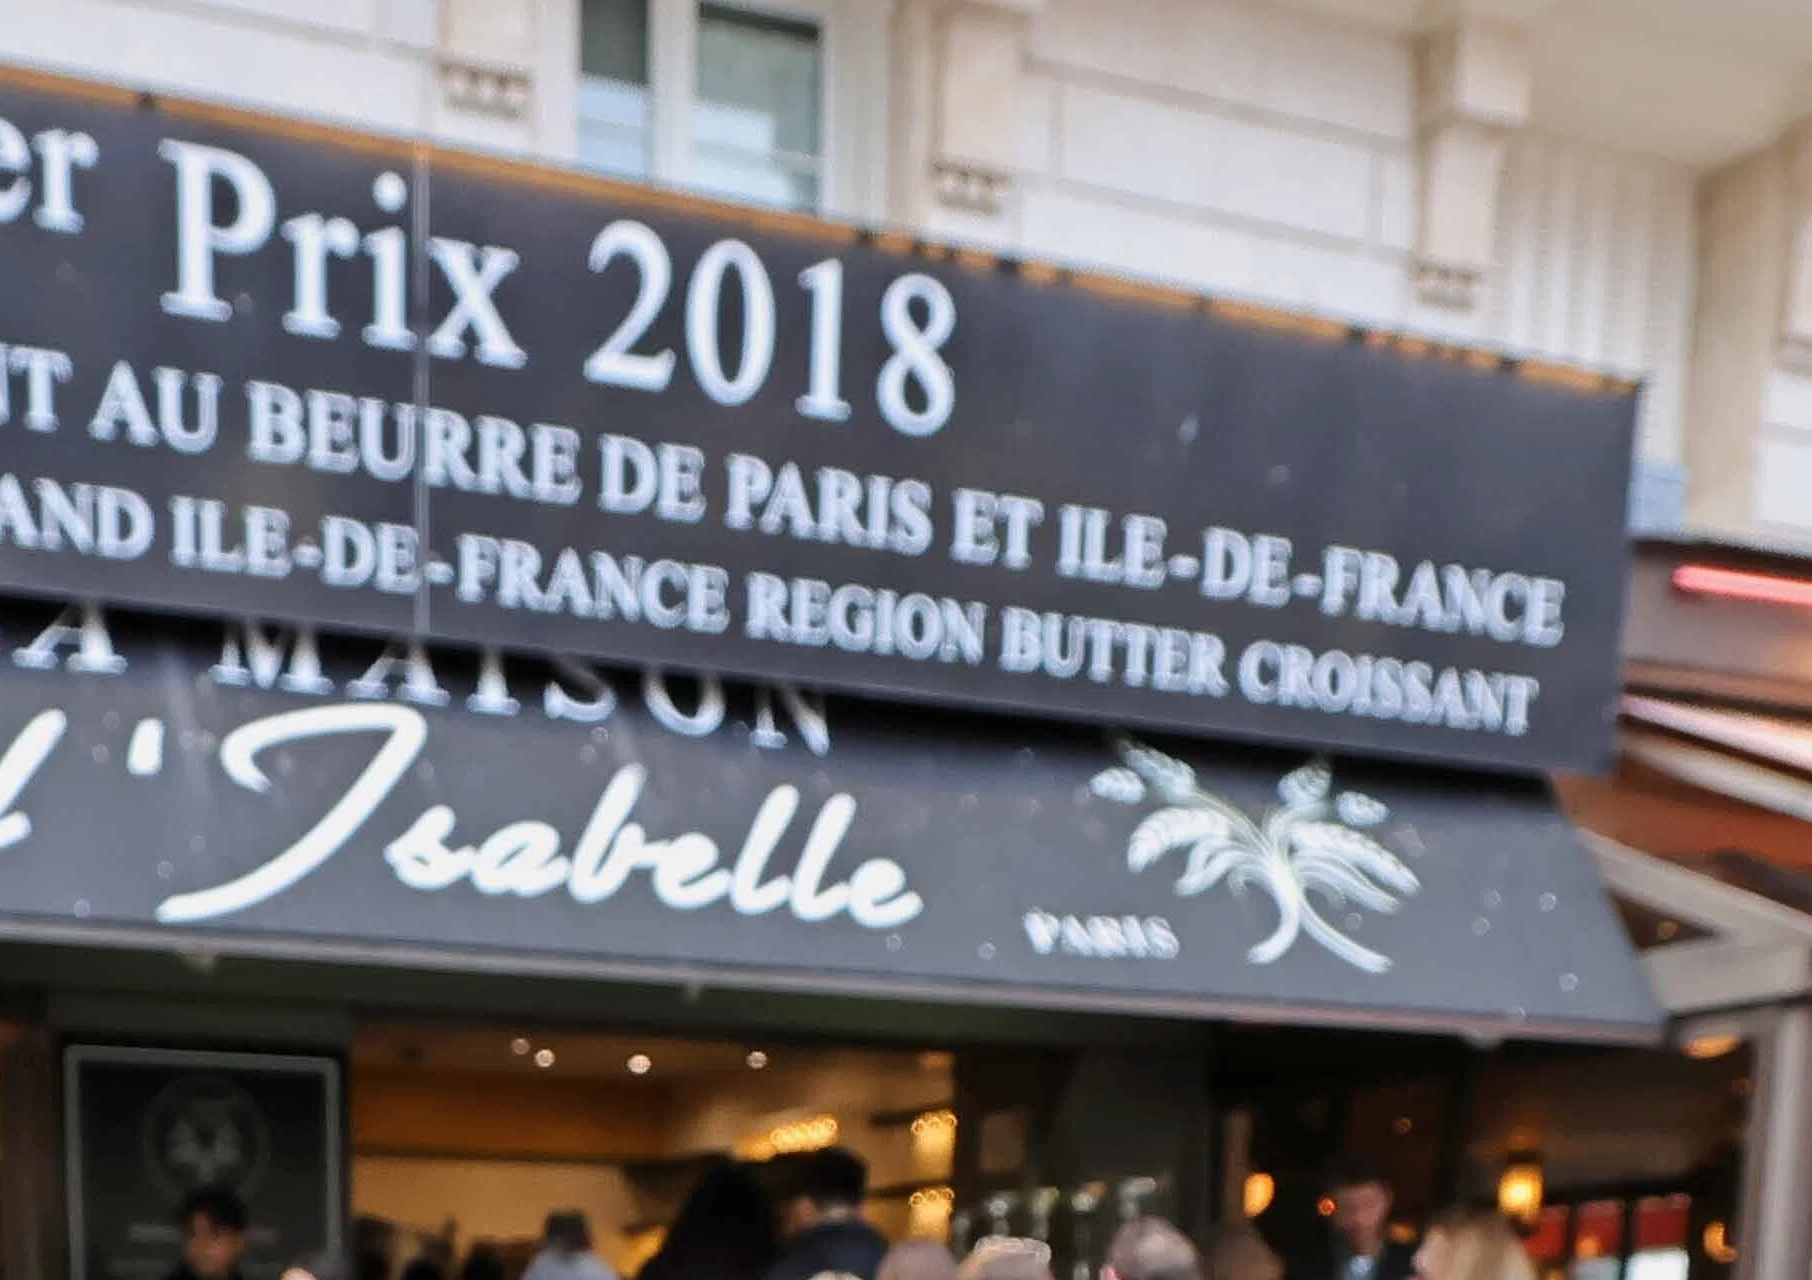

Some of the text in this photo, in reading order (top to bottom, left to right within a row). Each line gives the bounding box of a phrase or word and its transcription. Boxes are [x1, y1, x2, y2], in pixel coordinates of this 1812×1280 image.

[156, 138, 527, 369] Prix
[585, 220, 956, 437] 2018
[88, 361, 219, 453] AU
[245, 380, 581, 506] BEURRE
[598, 433, 705, 521] DE
[726, 452, 931, 557] PARIS
[952, 487, 1044, 568] ET
[1058, 504, 1565, 647] ILE-DE-FRANCE
[172, 495, 729, 634] ILE-DE-FRANCE
[745, 571, 985, 665] REGION
[1000, 608, 1230, 698] BUTTER
[1238, 641, 1539, 738] CROISSANT
[1024, 908, 1180, 958] PARIS
